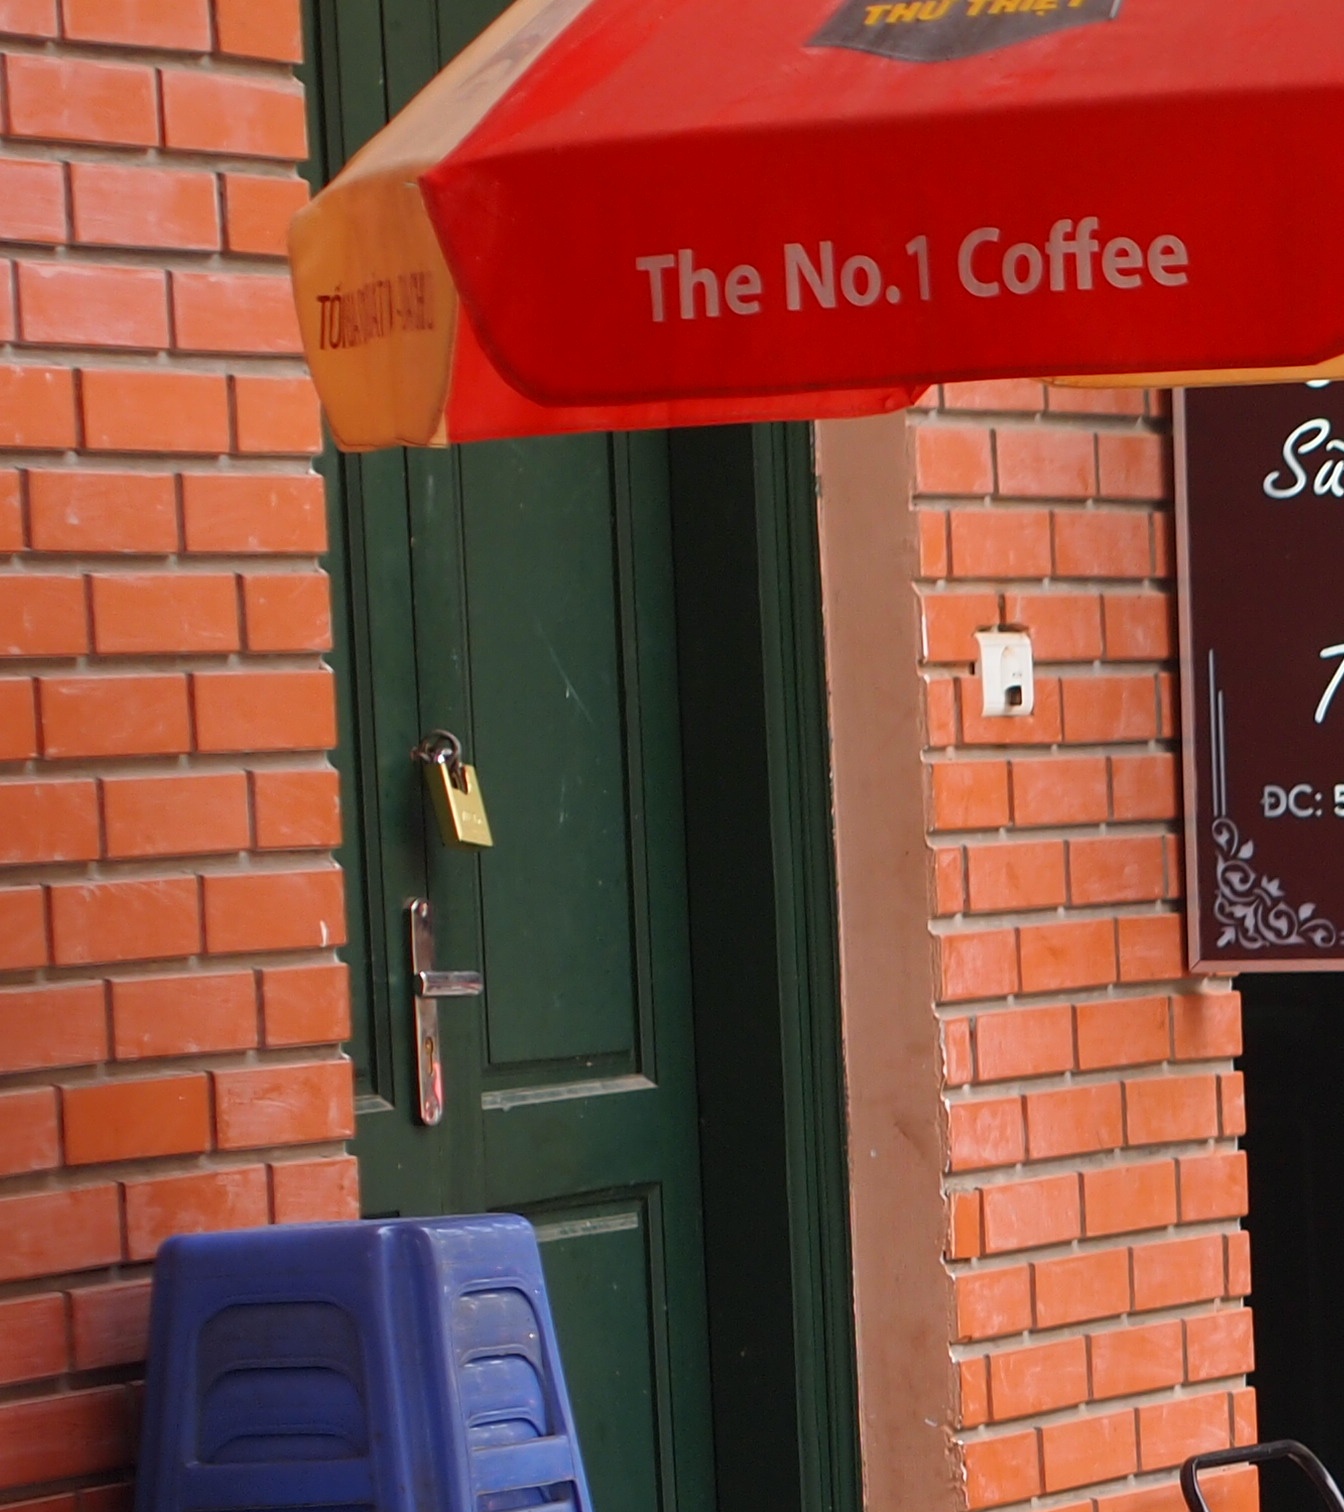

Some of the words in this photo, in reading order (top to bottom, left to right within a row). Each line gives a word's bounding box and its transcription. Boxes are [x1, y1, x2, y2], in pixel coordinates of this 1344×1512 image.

[635, 248, 763, 322] The
[958, 216, 1190, 298] Coffee
[1261, 783, 1323, 817] ĐC:
